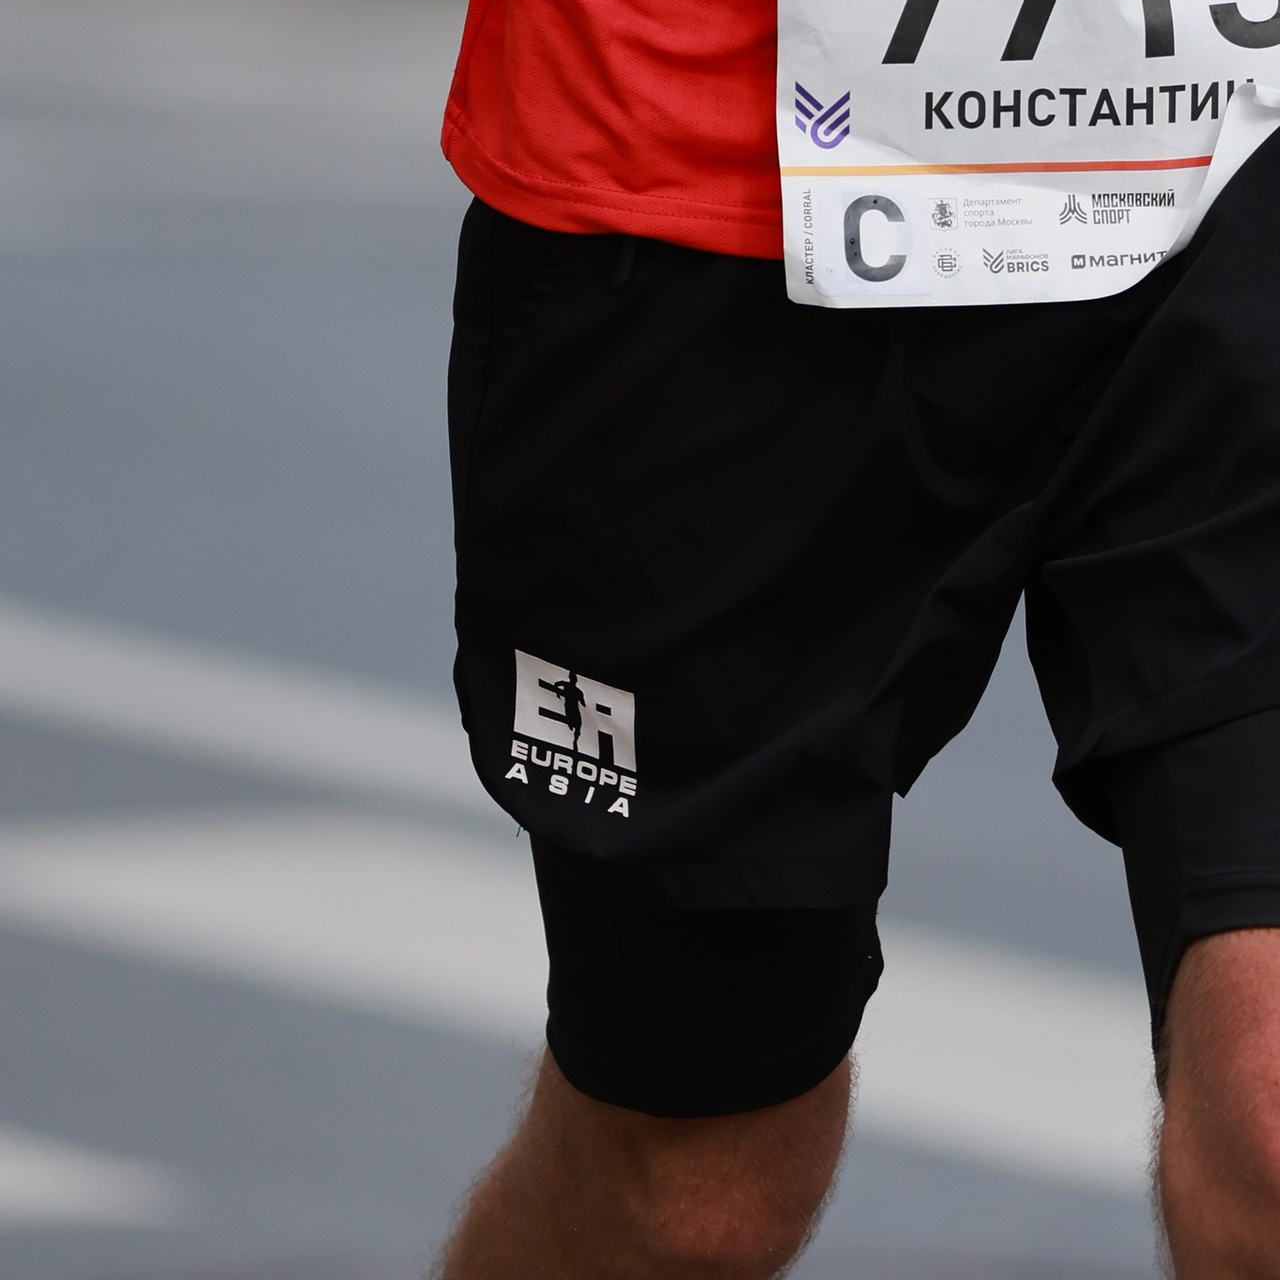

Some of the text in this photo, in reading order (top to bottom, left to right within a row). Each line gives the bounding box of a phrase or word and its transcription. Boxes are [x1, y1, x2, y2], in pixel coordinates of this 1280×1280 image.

[963, 199, 1022, 208] Департамент
[1092, 189, 1175, 208] МОСКОВСКИЙ
[802, 188, 813, 229] CORRAL
[964, 209, 994, 218] спорта
[1093, 209, 1131, 224] СПОРТ
[965, 221, 995, 229] города
[843, 194, 907, 283] C
[804, 238, 814, 285] КЛАСТЕР
[1007, 261, 1049, 273] BRICS
[511, 739, 638, 797] EUROPE
[505, 762, 629, 818] ASIA
